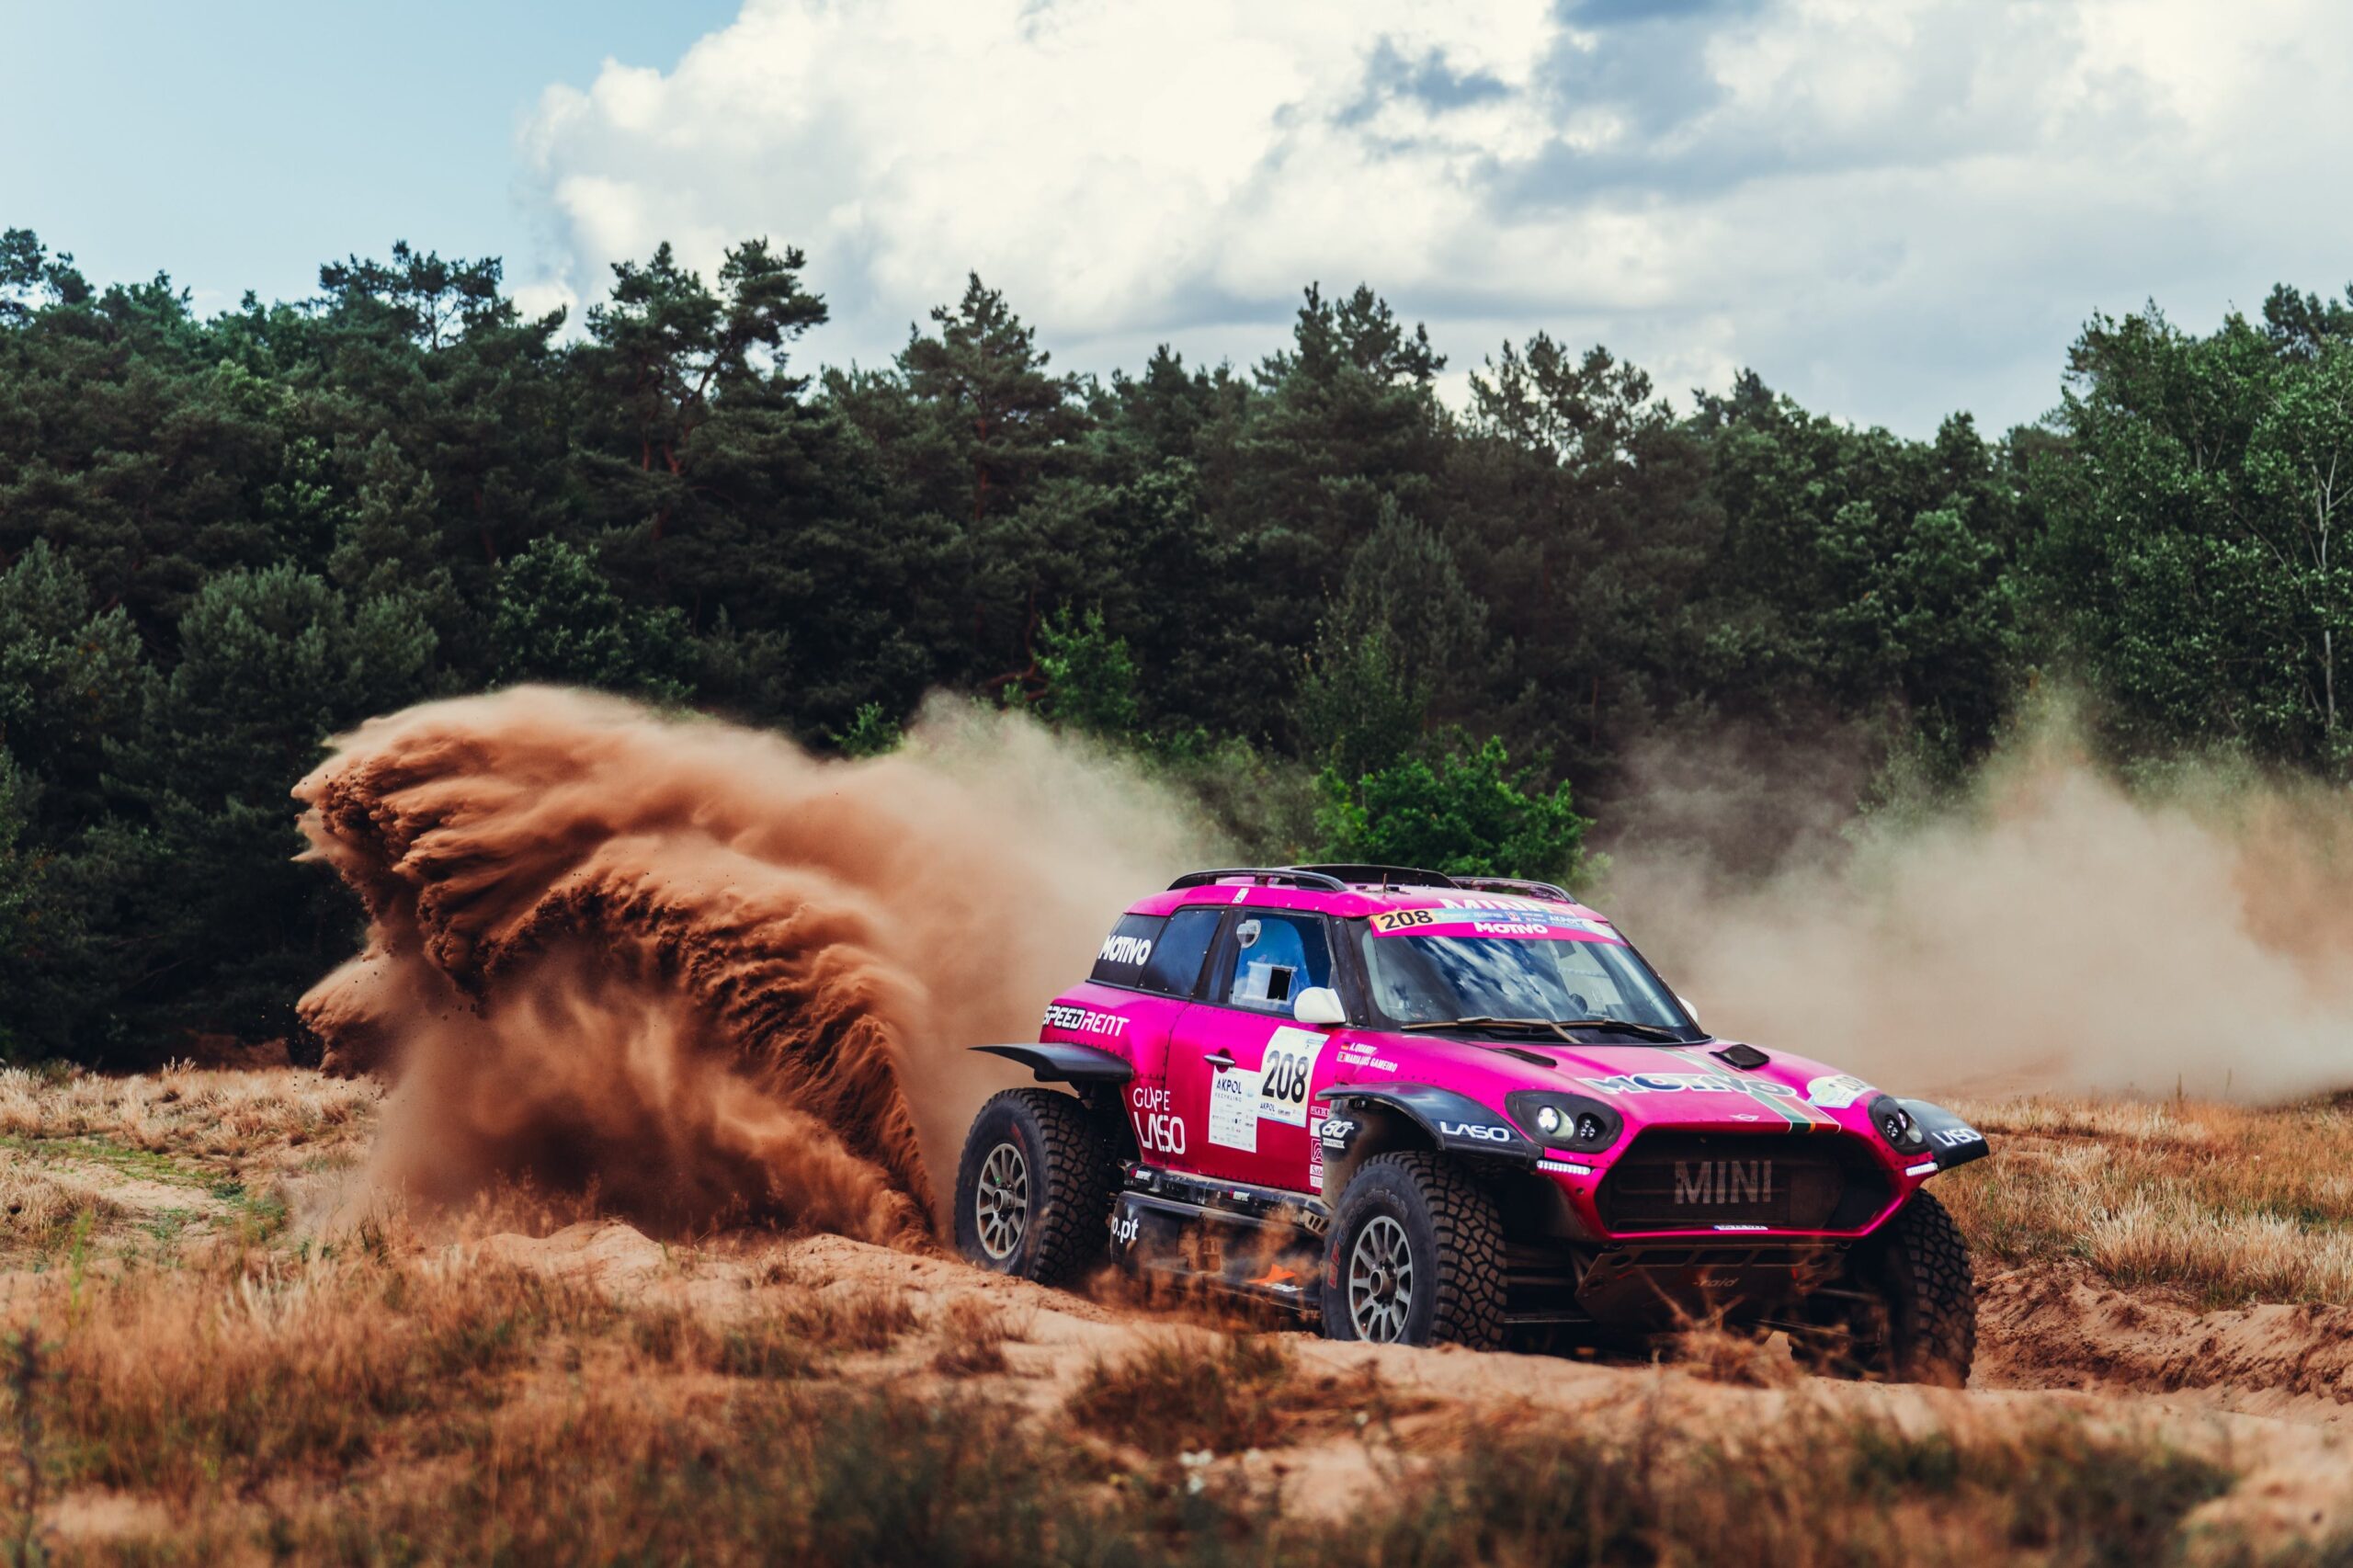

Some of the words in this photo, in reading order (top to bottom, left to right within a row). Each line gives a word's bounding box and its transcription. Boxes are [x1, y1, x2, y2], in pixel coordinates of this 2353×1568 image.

[1380, 910, 1434, 930] 208
[1473, 922, 1549, 934] MOTIVO
[1097, 935, 1152, 966] MOTIVO
[1216, 1078, 1242, 1095] AKPOL
[1262, 1050, 1310, 1104] 208
[1574, 1073, 1797, 1096] MOTIVO
[1133, 1111, 1186, 1155] LASO
[1439, 1120, 1510, 1142] LASO
[1931, 1128, 1983, 1147] LASO
[1674, 1160, 1772, 1205] MINI
